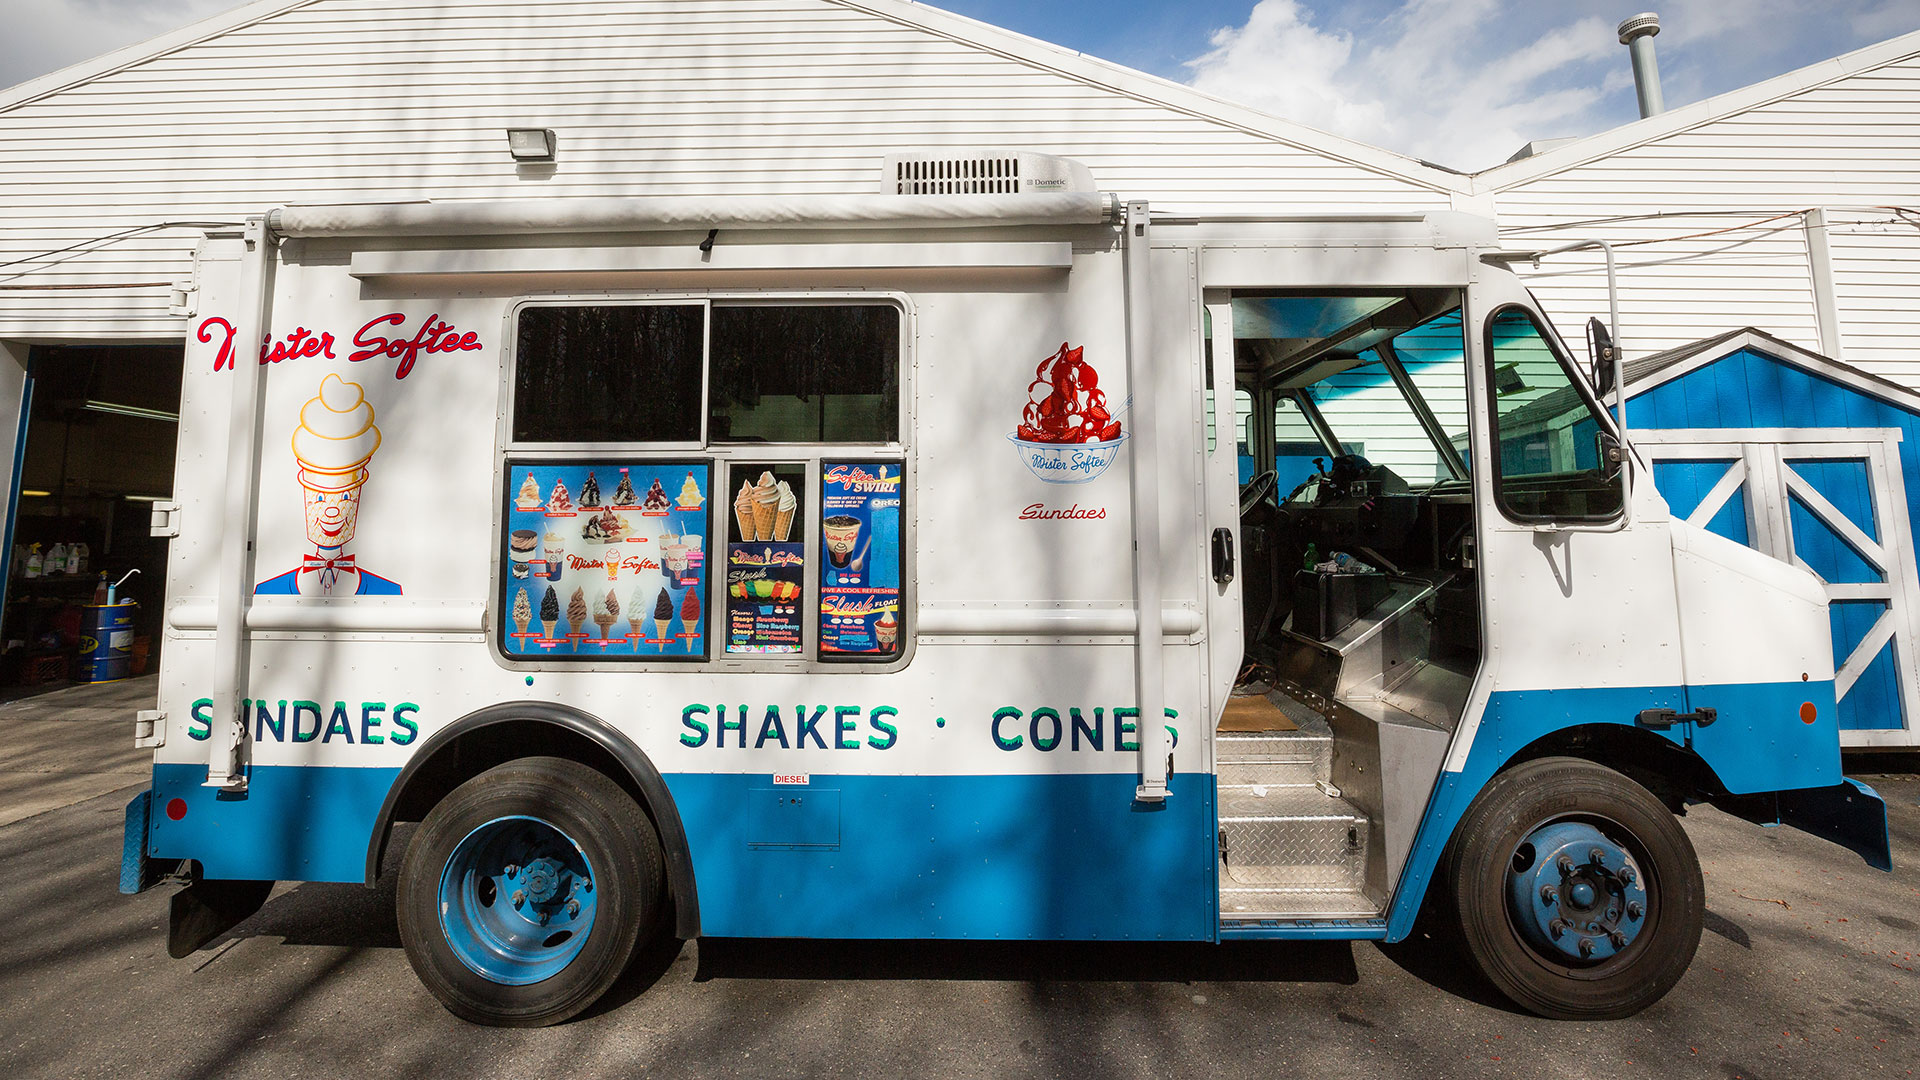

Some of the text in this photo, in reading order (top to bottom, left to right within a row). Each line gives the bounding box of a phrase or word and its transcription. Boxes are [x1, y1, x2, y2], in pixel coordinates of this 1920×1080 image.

[349, 313, 483, 380] Softee
[1032, 452, 1106, 473] Mister Softee
[826, 465, 876, 490] Softee
[853, 482, 896, 493] SWIRL
[871, 498, 900, 507] OREO
[1018, 503, 1107, 520] Sundaes
[566, 553, 660, 575] Mister Softee
[733, 549, 802, 567] Mister Softee
[821, 595, 875, 614] Slush
[874, 599, 898, 607] FLOAT
[679, 703, 899, 750] SHAKES
[775, 775, 808, 784] DIESEL
